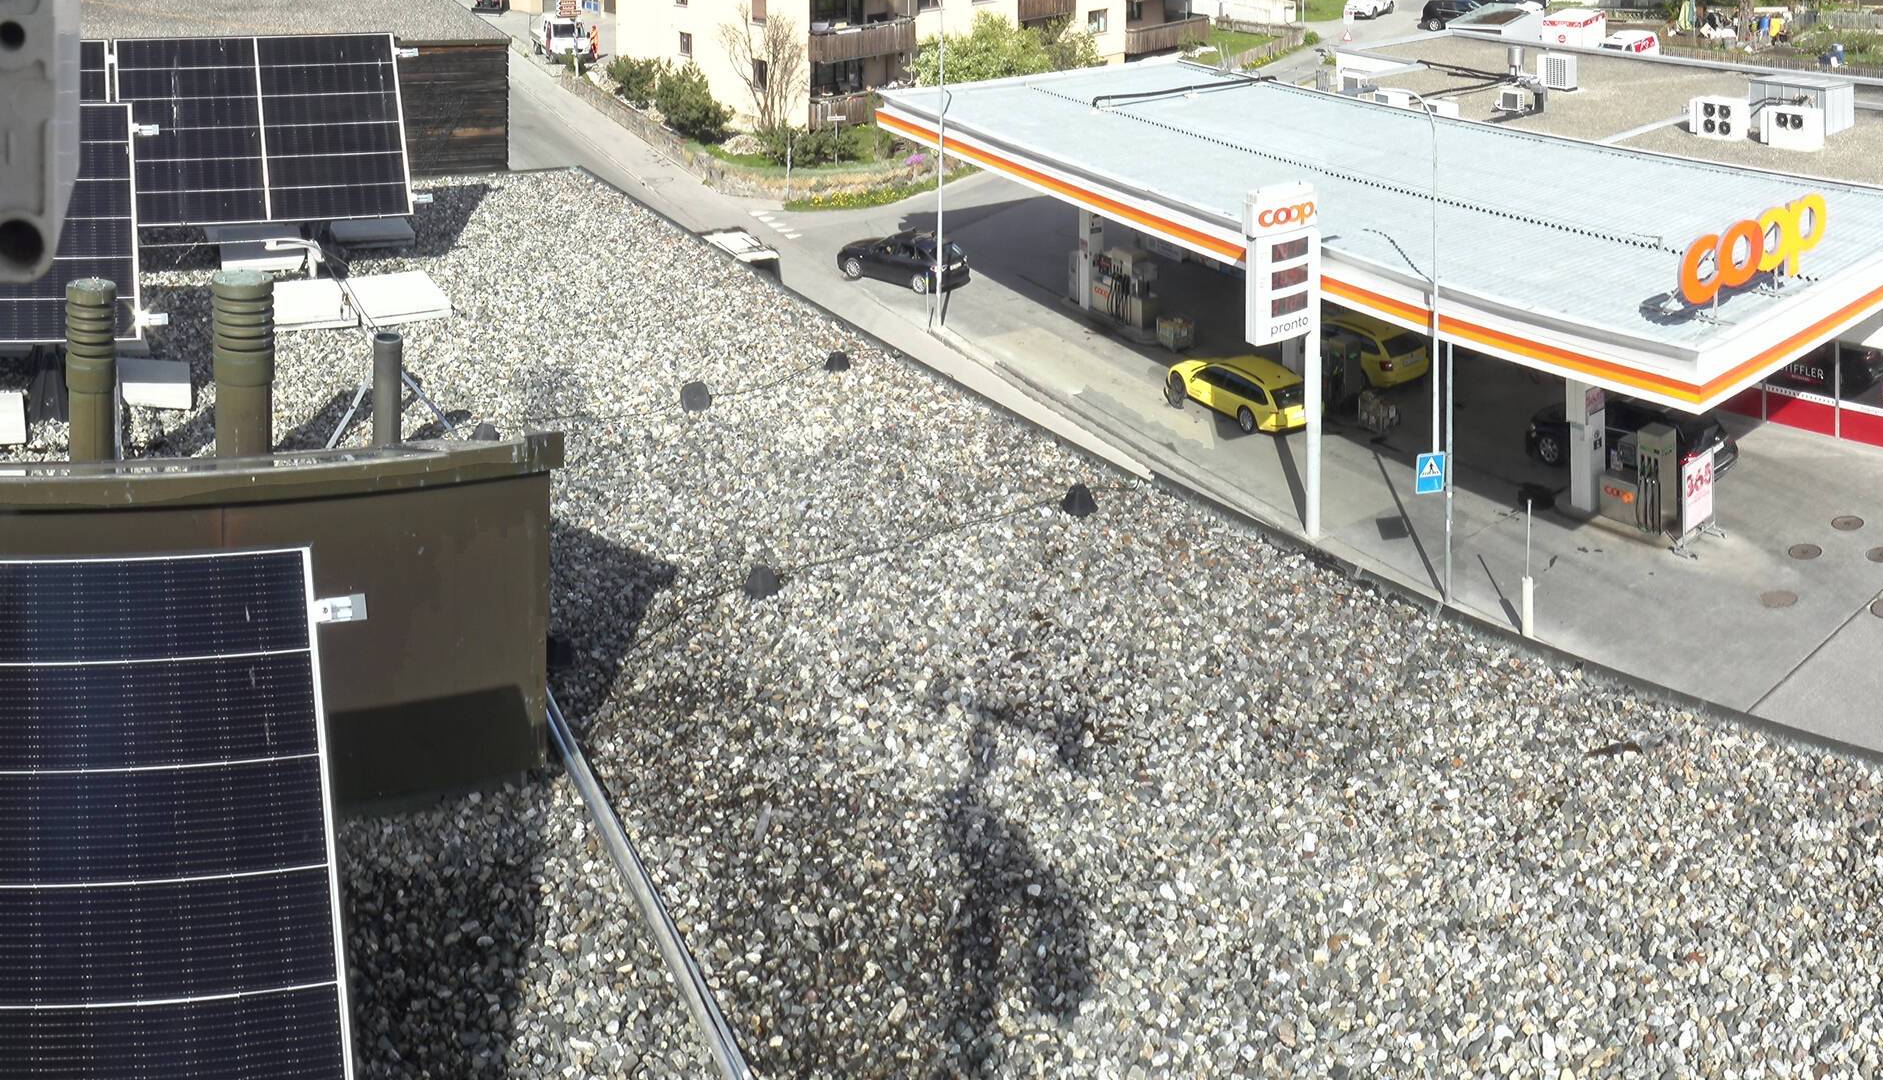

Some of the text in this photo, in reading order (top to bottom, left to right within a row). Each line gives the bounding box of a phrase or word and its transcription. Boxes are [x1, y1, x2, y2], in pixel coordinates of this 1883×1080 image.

[1258, 201, 1315, 228] coop
[1677, 193, 1828, 305] coop
[1270, 315, 1310, 337] pronto
